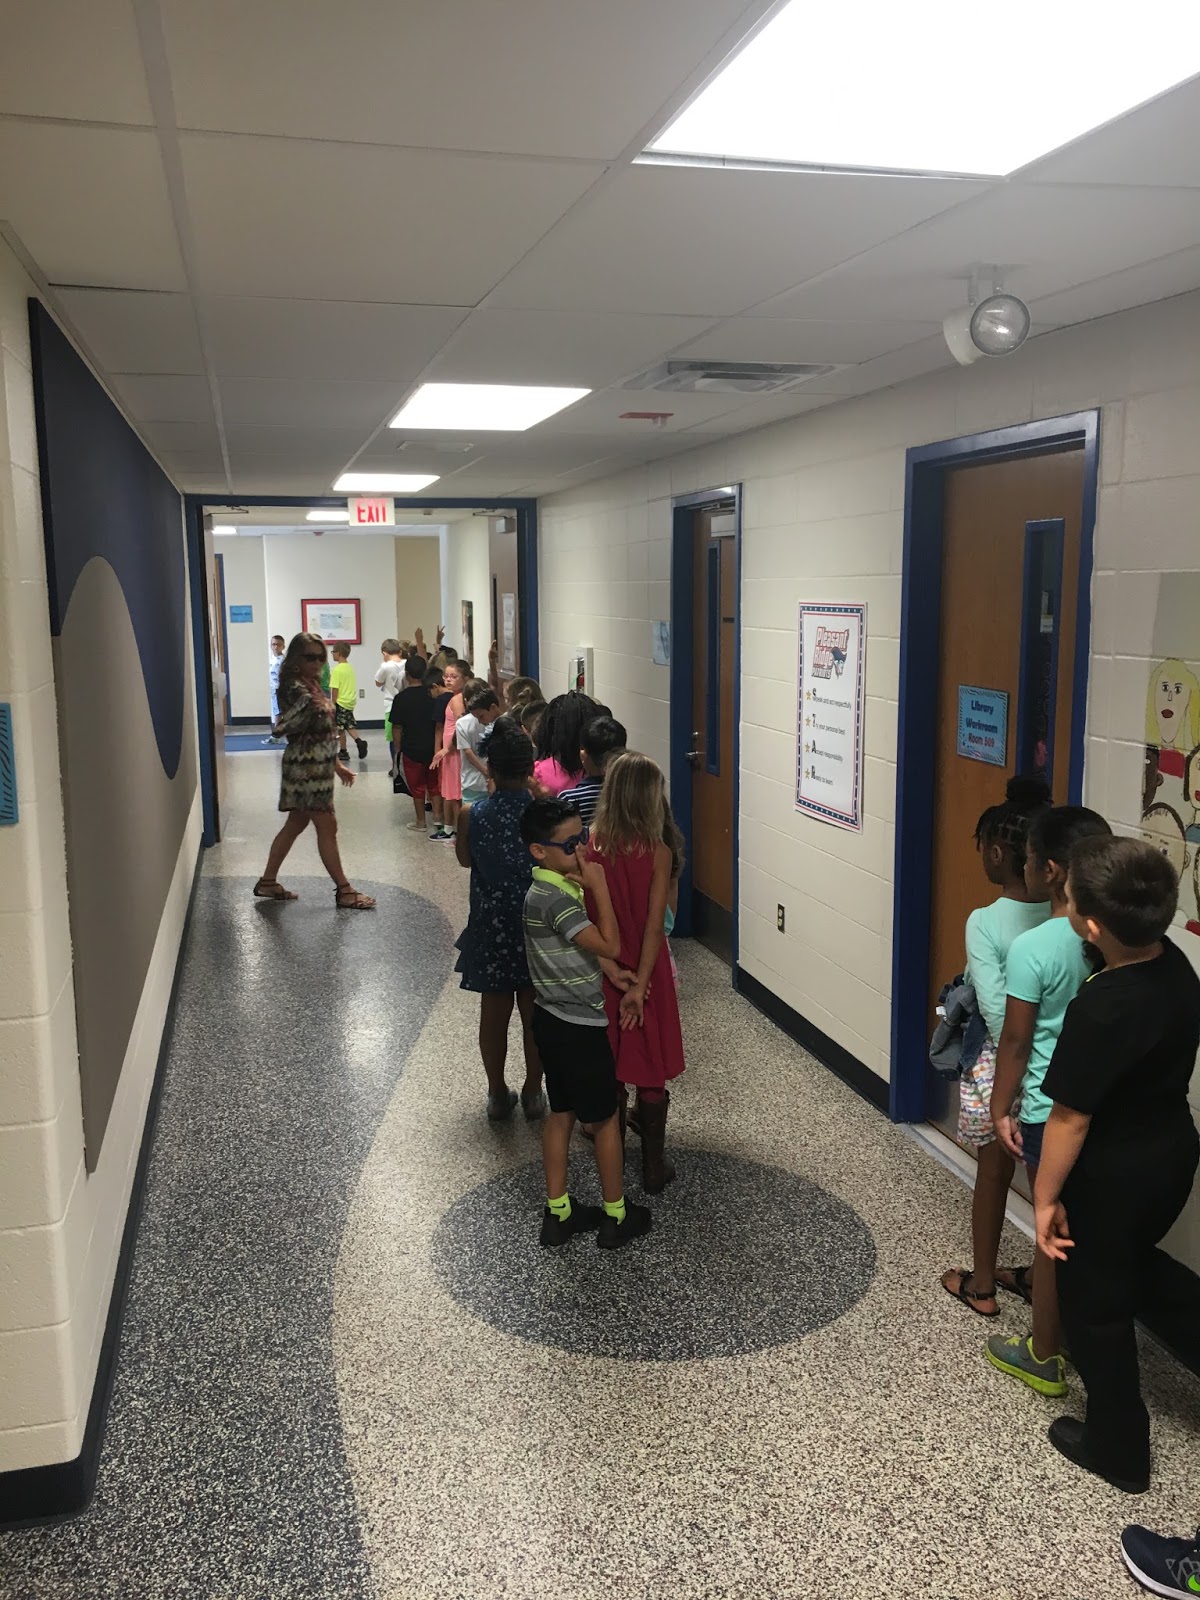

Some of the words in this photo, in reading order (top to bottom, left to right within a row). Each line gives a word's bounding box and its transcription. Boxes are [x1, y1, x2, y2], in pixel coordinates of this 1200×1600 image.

[356, 498, 386, 523] EXIT
[816, 626, 849, 651] Pleasant
[813, 646, 833, 669] Ridge
[971, 700, 994, 715] Library
[965, 718, 998, 734] Workroom
[968, 733, 983, 746] Room
